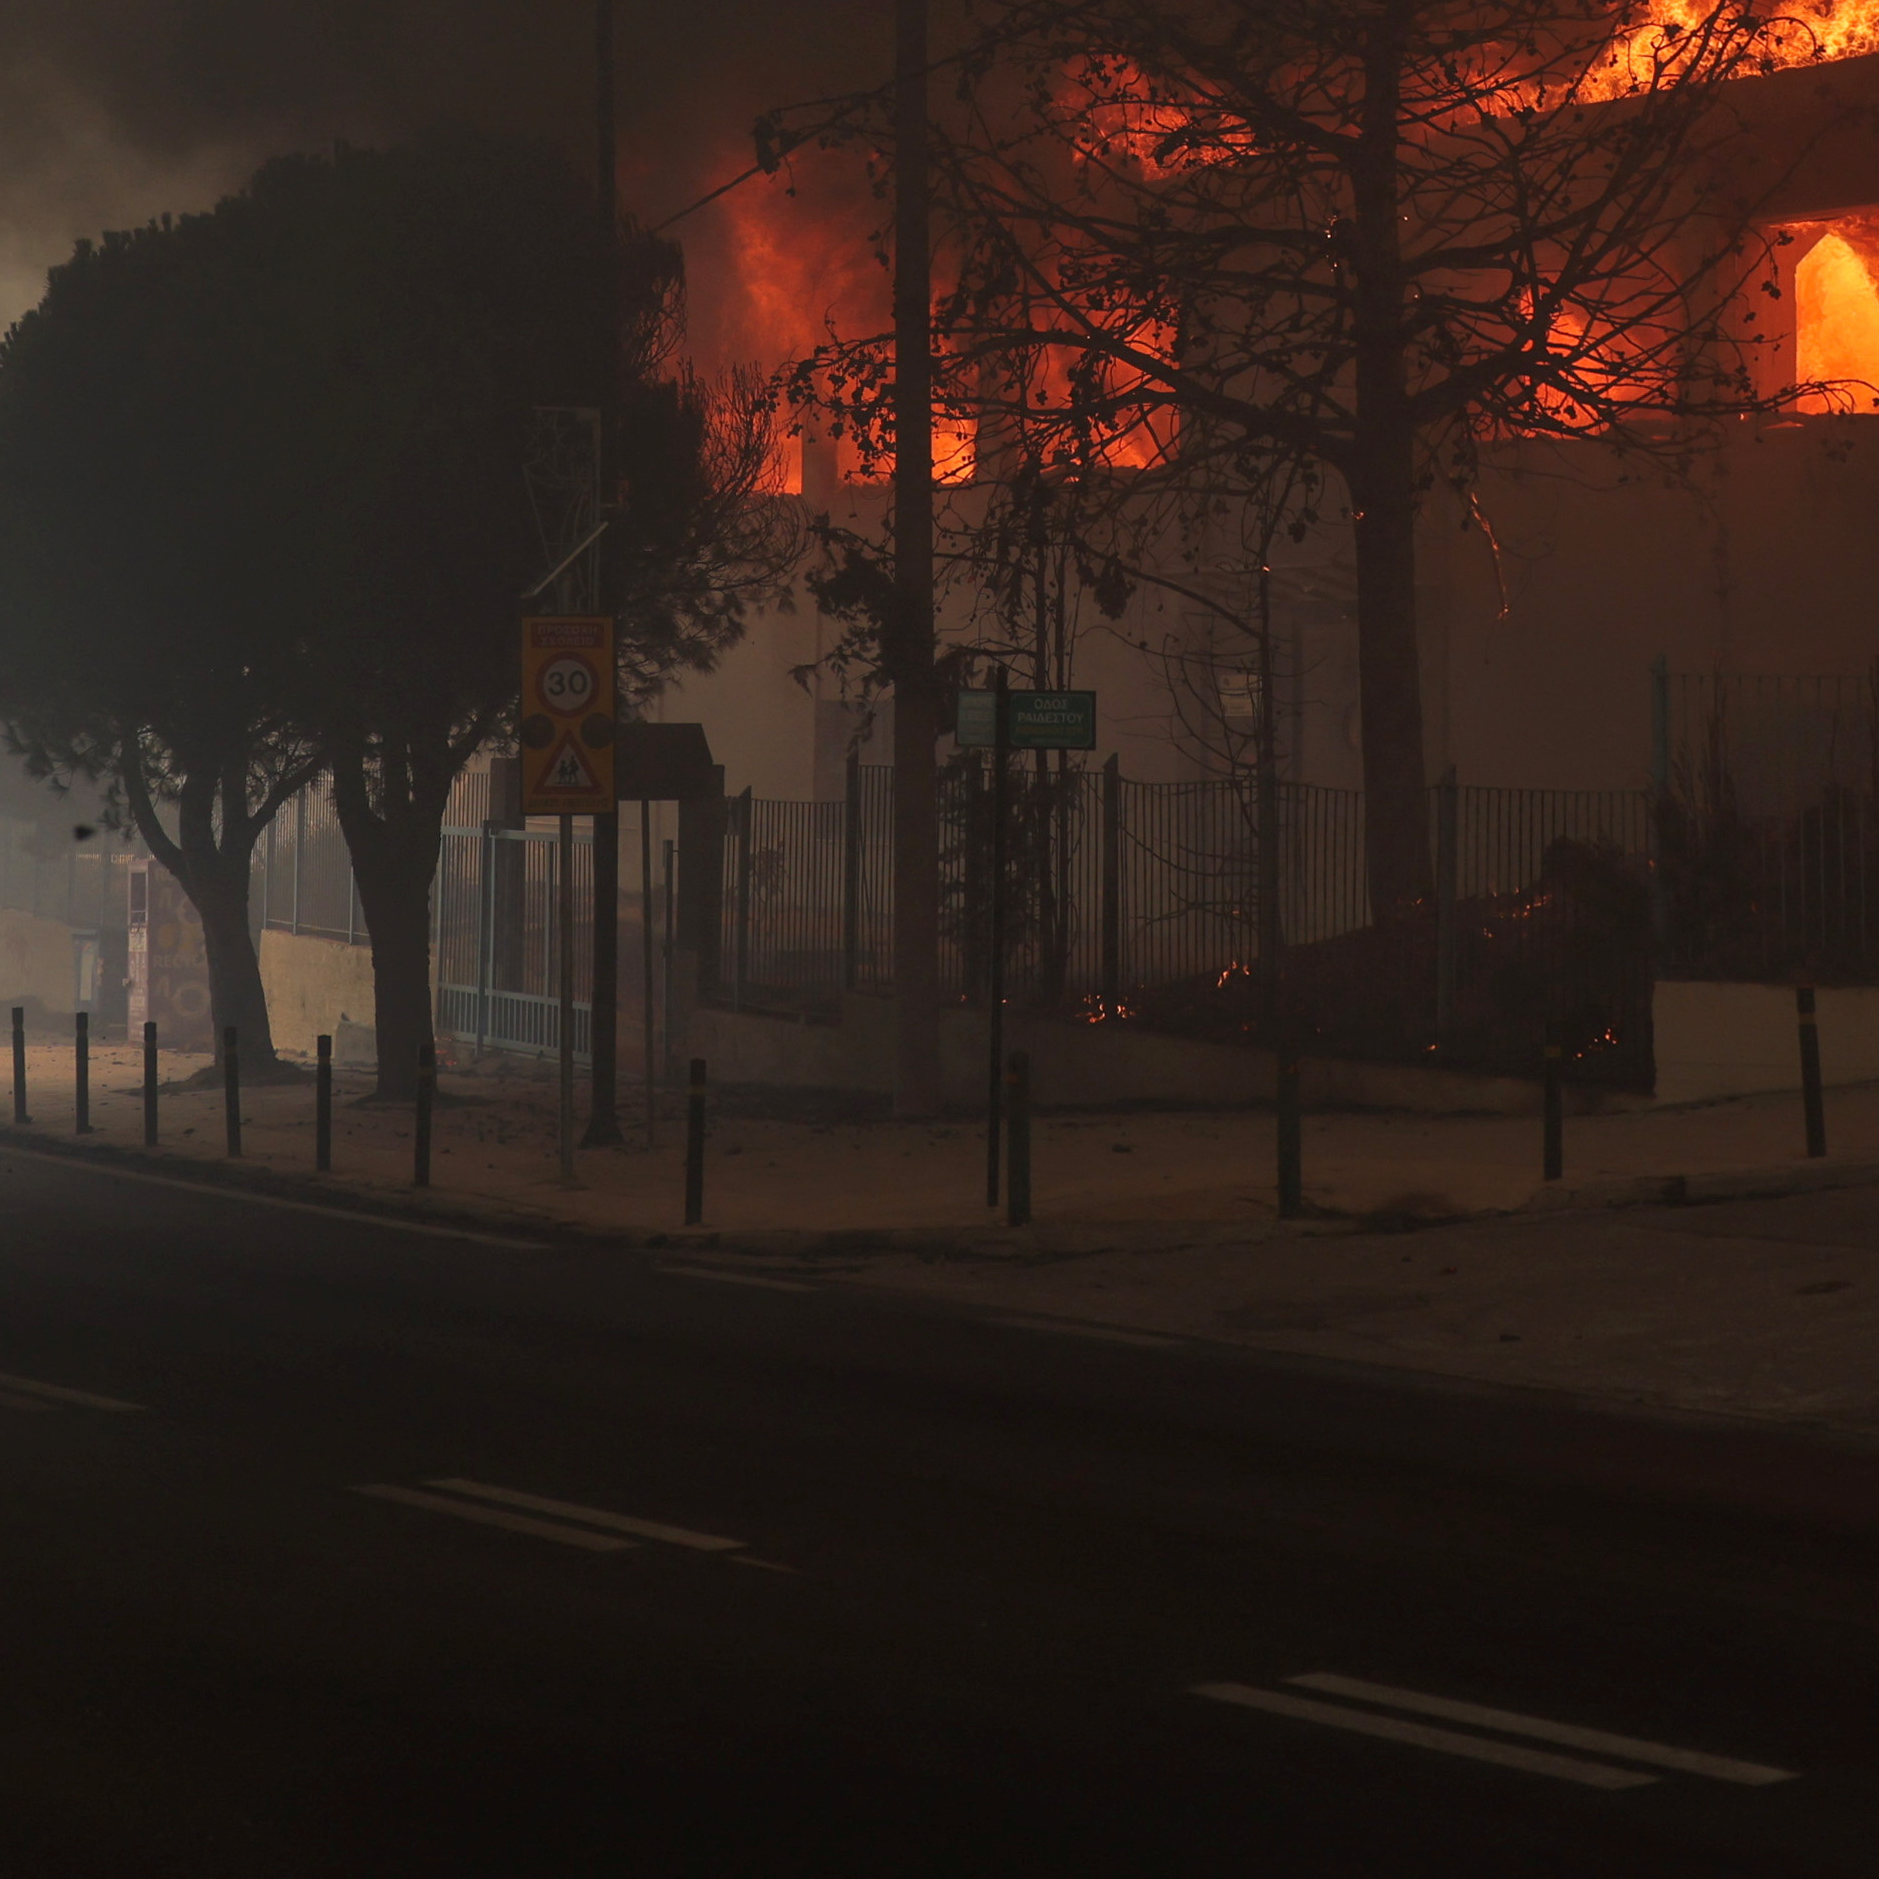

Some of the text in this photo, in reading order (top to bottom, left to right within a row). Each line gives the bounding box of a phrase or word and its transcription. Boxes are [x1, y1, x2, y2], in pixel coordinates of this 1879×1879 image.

[537, 625, 598, 635] ΠΡΟΣΟΧΗ
[540, 636, 595, 646] ΣΧΟΛΕΙΟ
[548, 670, 588, 696] 30
[1033, 698, 1068, 710] ΟΔΟΣ
[1017, 712, 1084, 723] ΡΑΙΔΕΣΤΟΥ
